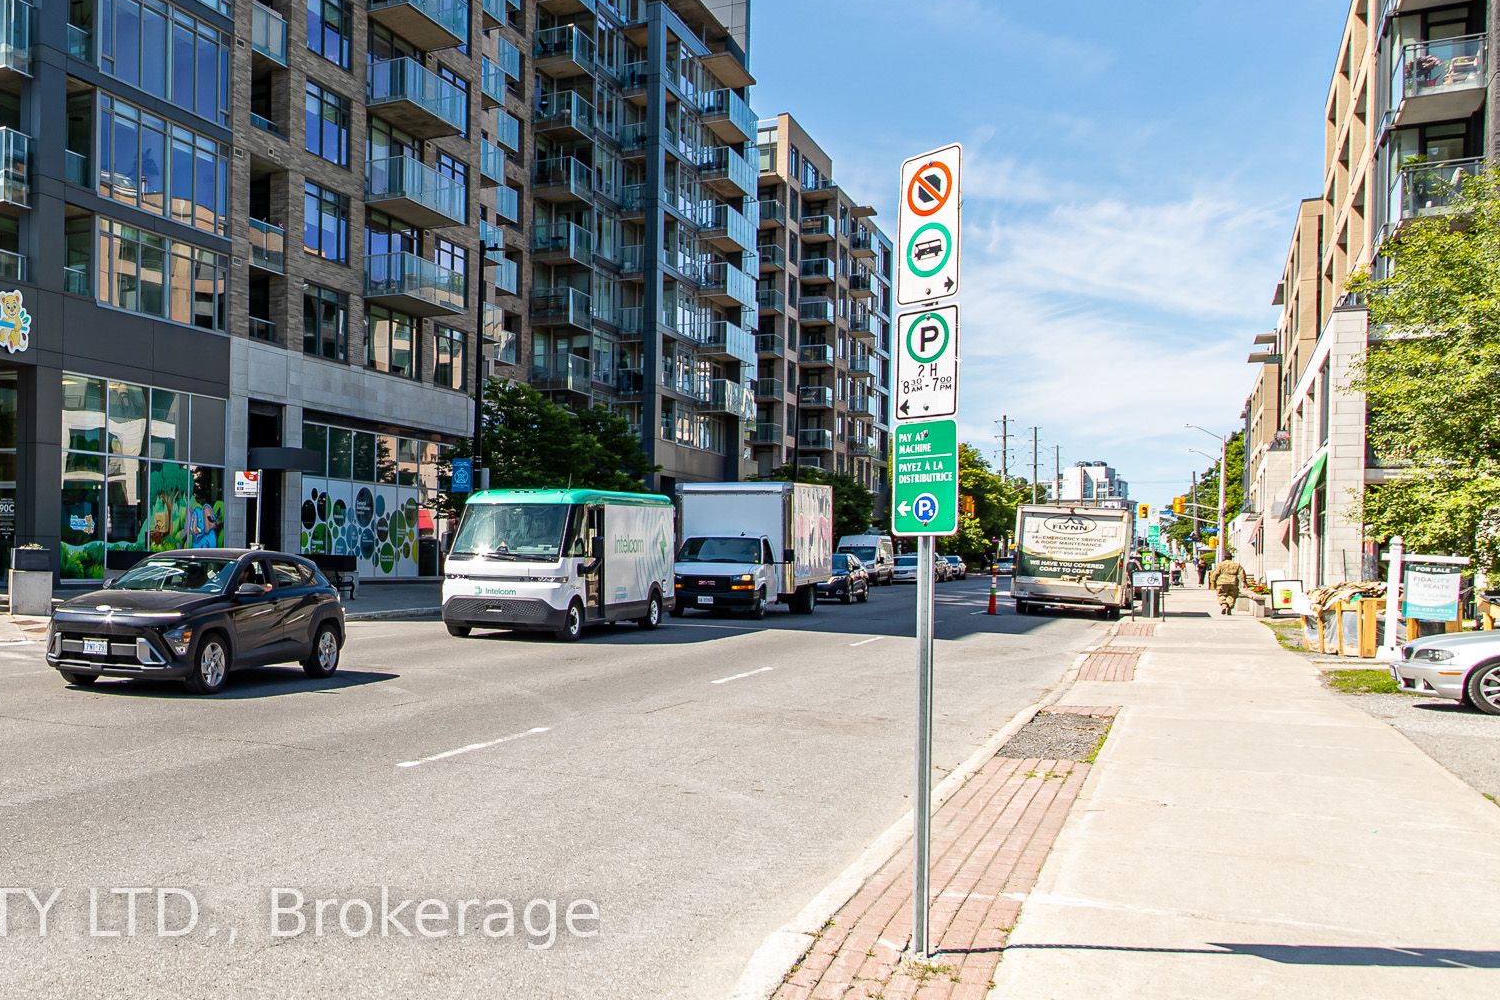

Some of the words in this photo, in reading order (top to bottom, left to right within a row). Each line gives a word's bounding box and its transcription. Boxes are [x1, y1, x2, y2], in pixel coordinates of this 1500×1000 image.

[920, 325, 939, 352] P
[930, 362, 937, 377] H
[899, 433, 912, 443] PAY
[915, 432, 925, 441] AT
[899, 443, 931, 454] MACHINE
[899, 462, 921, 472] PAYEZ
[933, 460, 943, 470] LA
[899, 472, 953, 484] DISTRIBUTRICE
[0, 504, 15, 513] 90C
[1052, 523, 1088, 531] FLYNN
[615, 533, 644, 554] Intelcom
[485, 587, 516, 596] Intelcom
